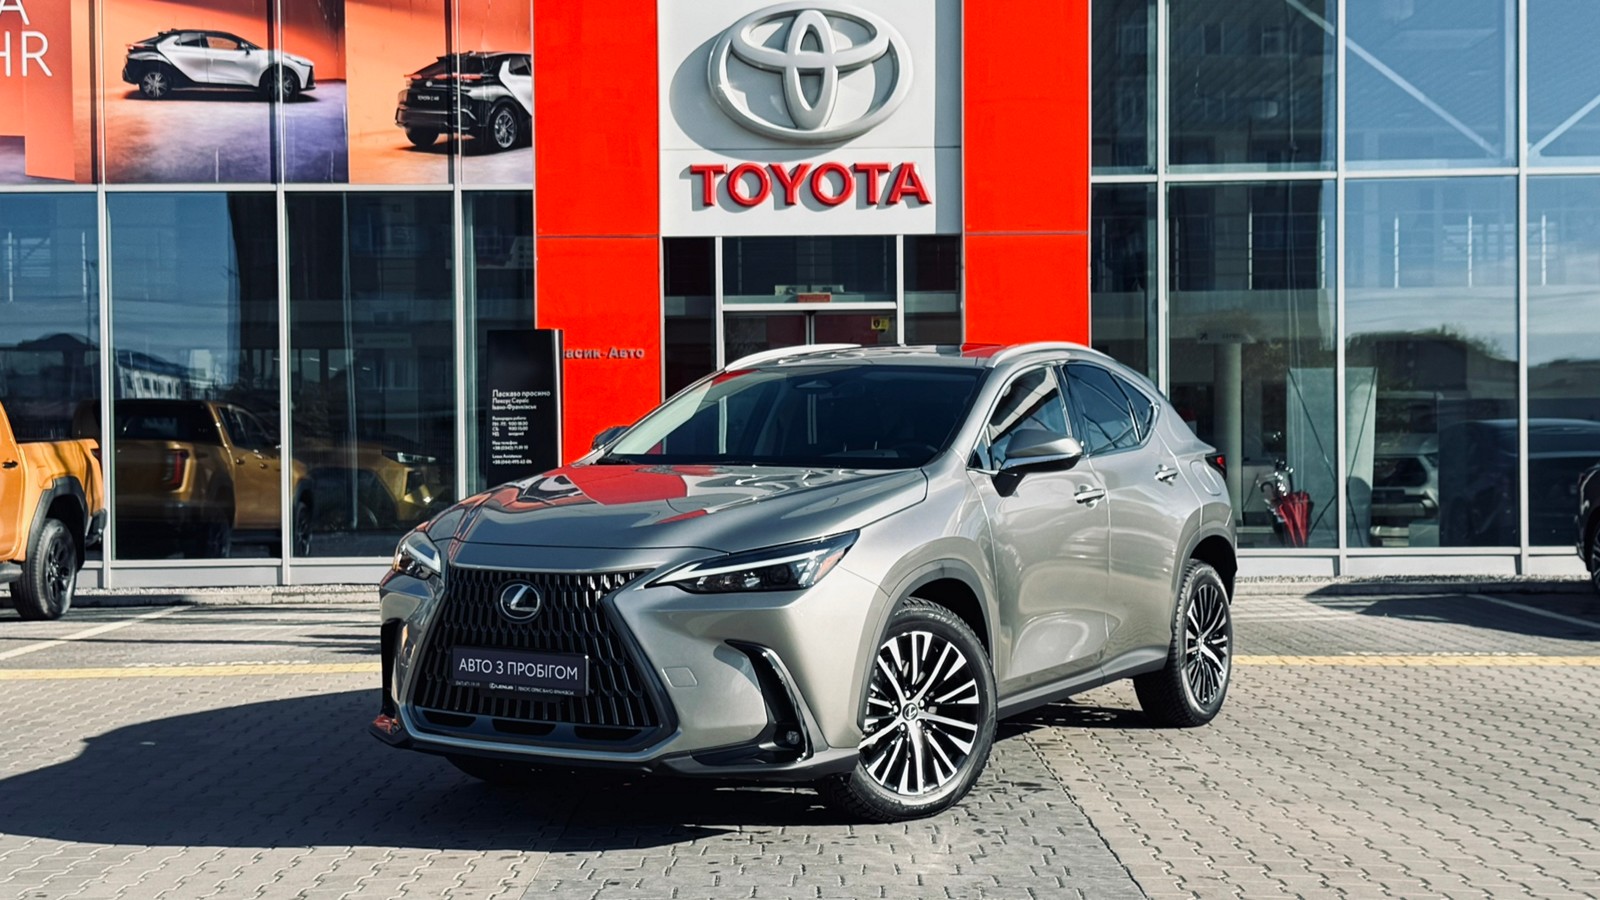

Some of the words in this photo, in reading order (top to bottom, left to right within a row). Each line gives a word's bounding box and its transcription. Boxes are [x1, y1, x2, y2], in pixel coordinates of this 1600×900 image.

[690, 161, 932, 207] TOYOTA
[563, 347, 645, 359] асик-Авто
[458, 658, 493, 673] АВТО
[507, 661, 578, 681] ПРОБІГОМ
